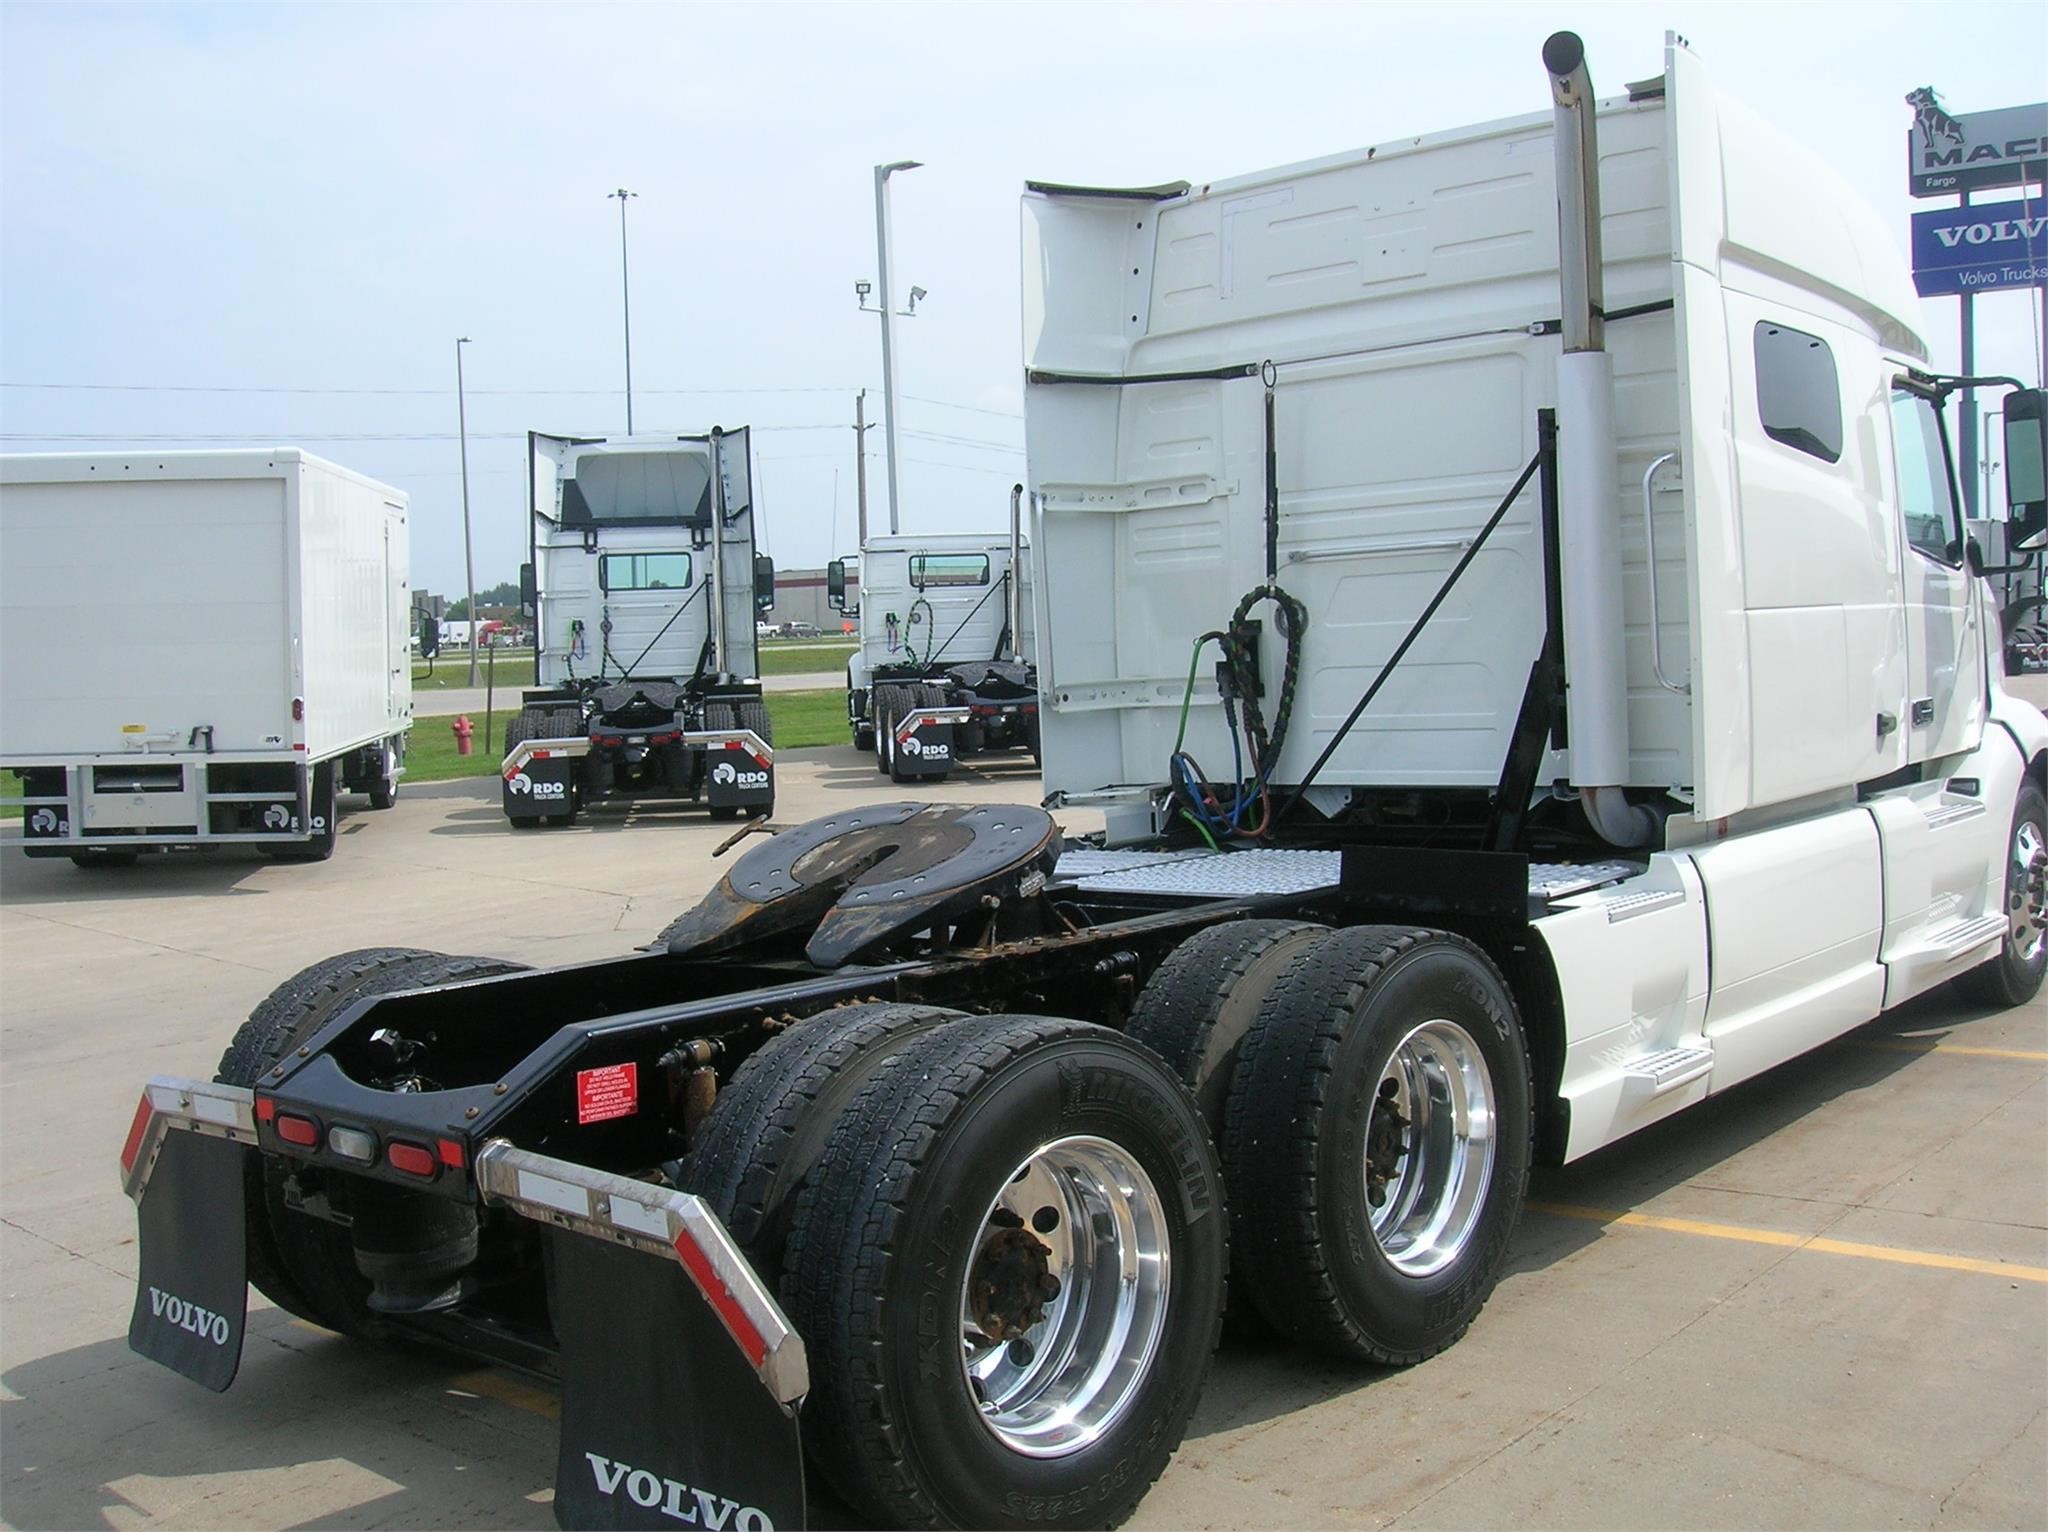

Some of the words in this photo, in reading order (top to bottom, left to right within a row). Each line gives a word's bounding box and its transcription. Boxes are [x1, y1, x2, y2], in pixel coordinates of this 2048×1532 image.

[1926, 175, 1957, 188] Fargo
[1933, 216, 2048, 248] VOLV
[1959, 270, 1997, 286] Volvo
[2001, 264, 2048, 281] Trucks
[922, 744, 949, 755] RDO
[737, 771, 768, 783] RDO
[533, 782, 564, 794] RDO
[149, 1286, 229, 1345] VOLVO
[585, 1452, 775, 1532] VOLVO
